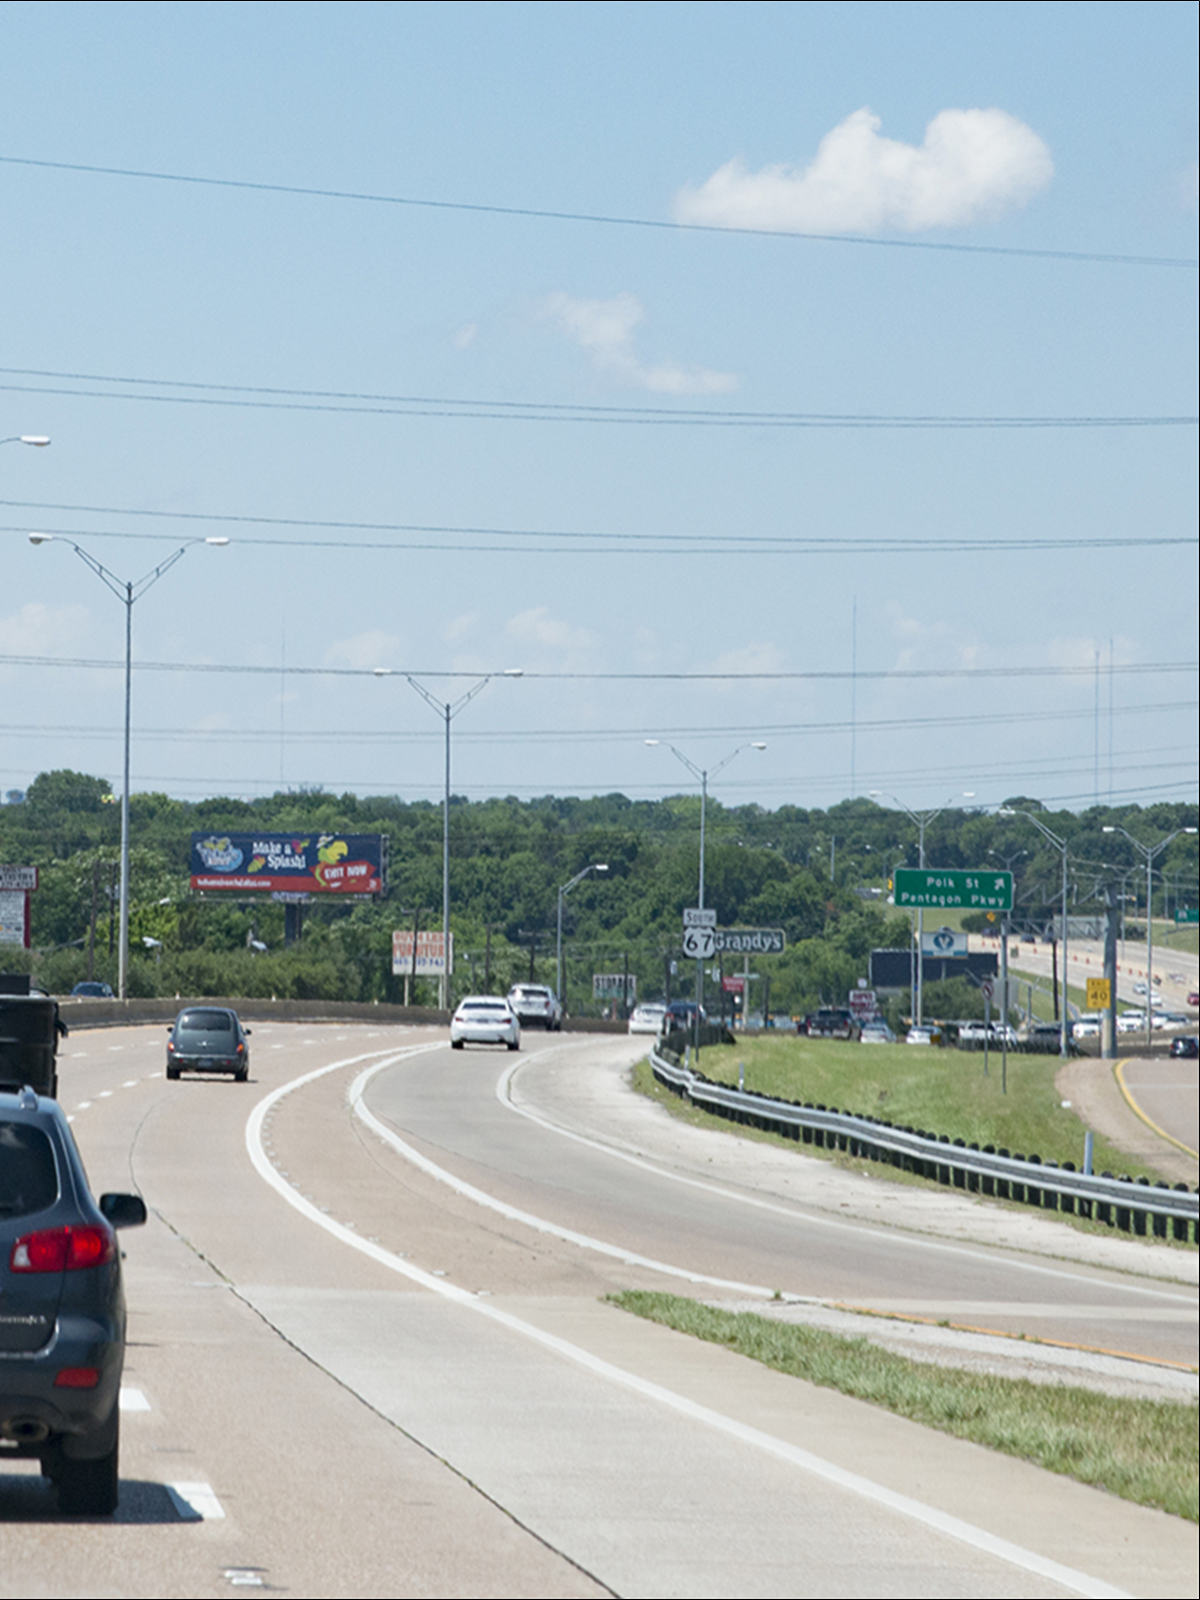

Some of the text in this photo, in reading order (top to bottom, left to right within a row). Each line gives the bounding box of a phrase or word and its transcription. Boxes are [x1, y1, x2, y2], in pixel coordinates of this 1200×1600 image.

[252, 842, 292, 854] Make a
[267, 855, 306, 869] Splash!
[324, 865, 368, 879] EXIT NOW
[926, 876, 980, 889] Polk St
[901, 892, 1005, 907] Pentagon Pkwy
[686, 911, 714, 923] SOUTH
[686, 934, 712, 952] 67
[715, 932, 781, 951] Grandy's
[595, 977, 634, 990] STORAE
[1091, 991, 1108, 1000] 40
